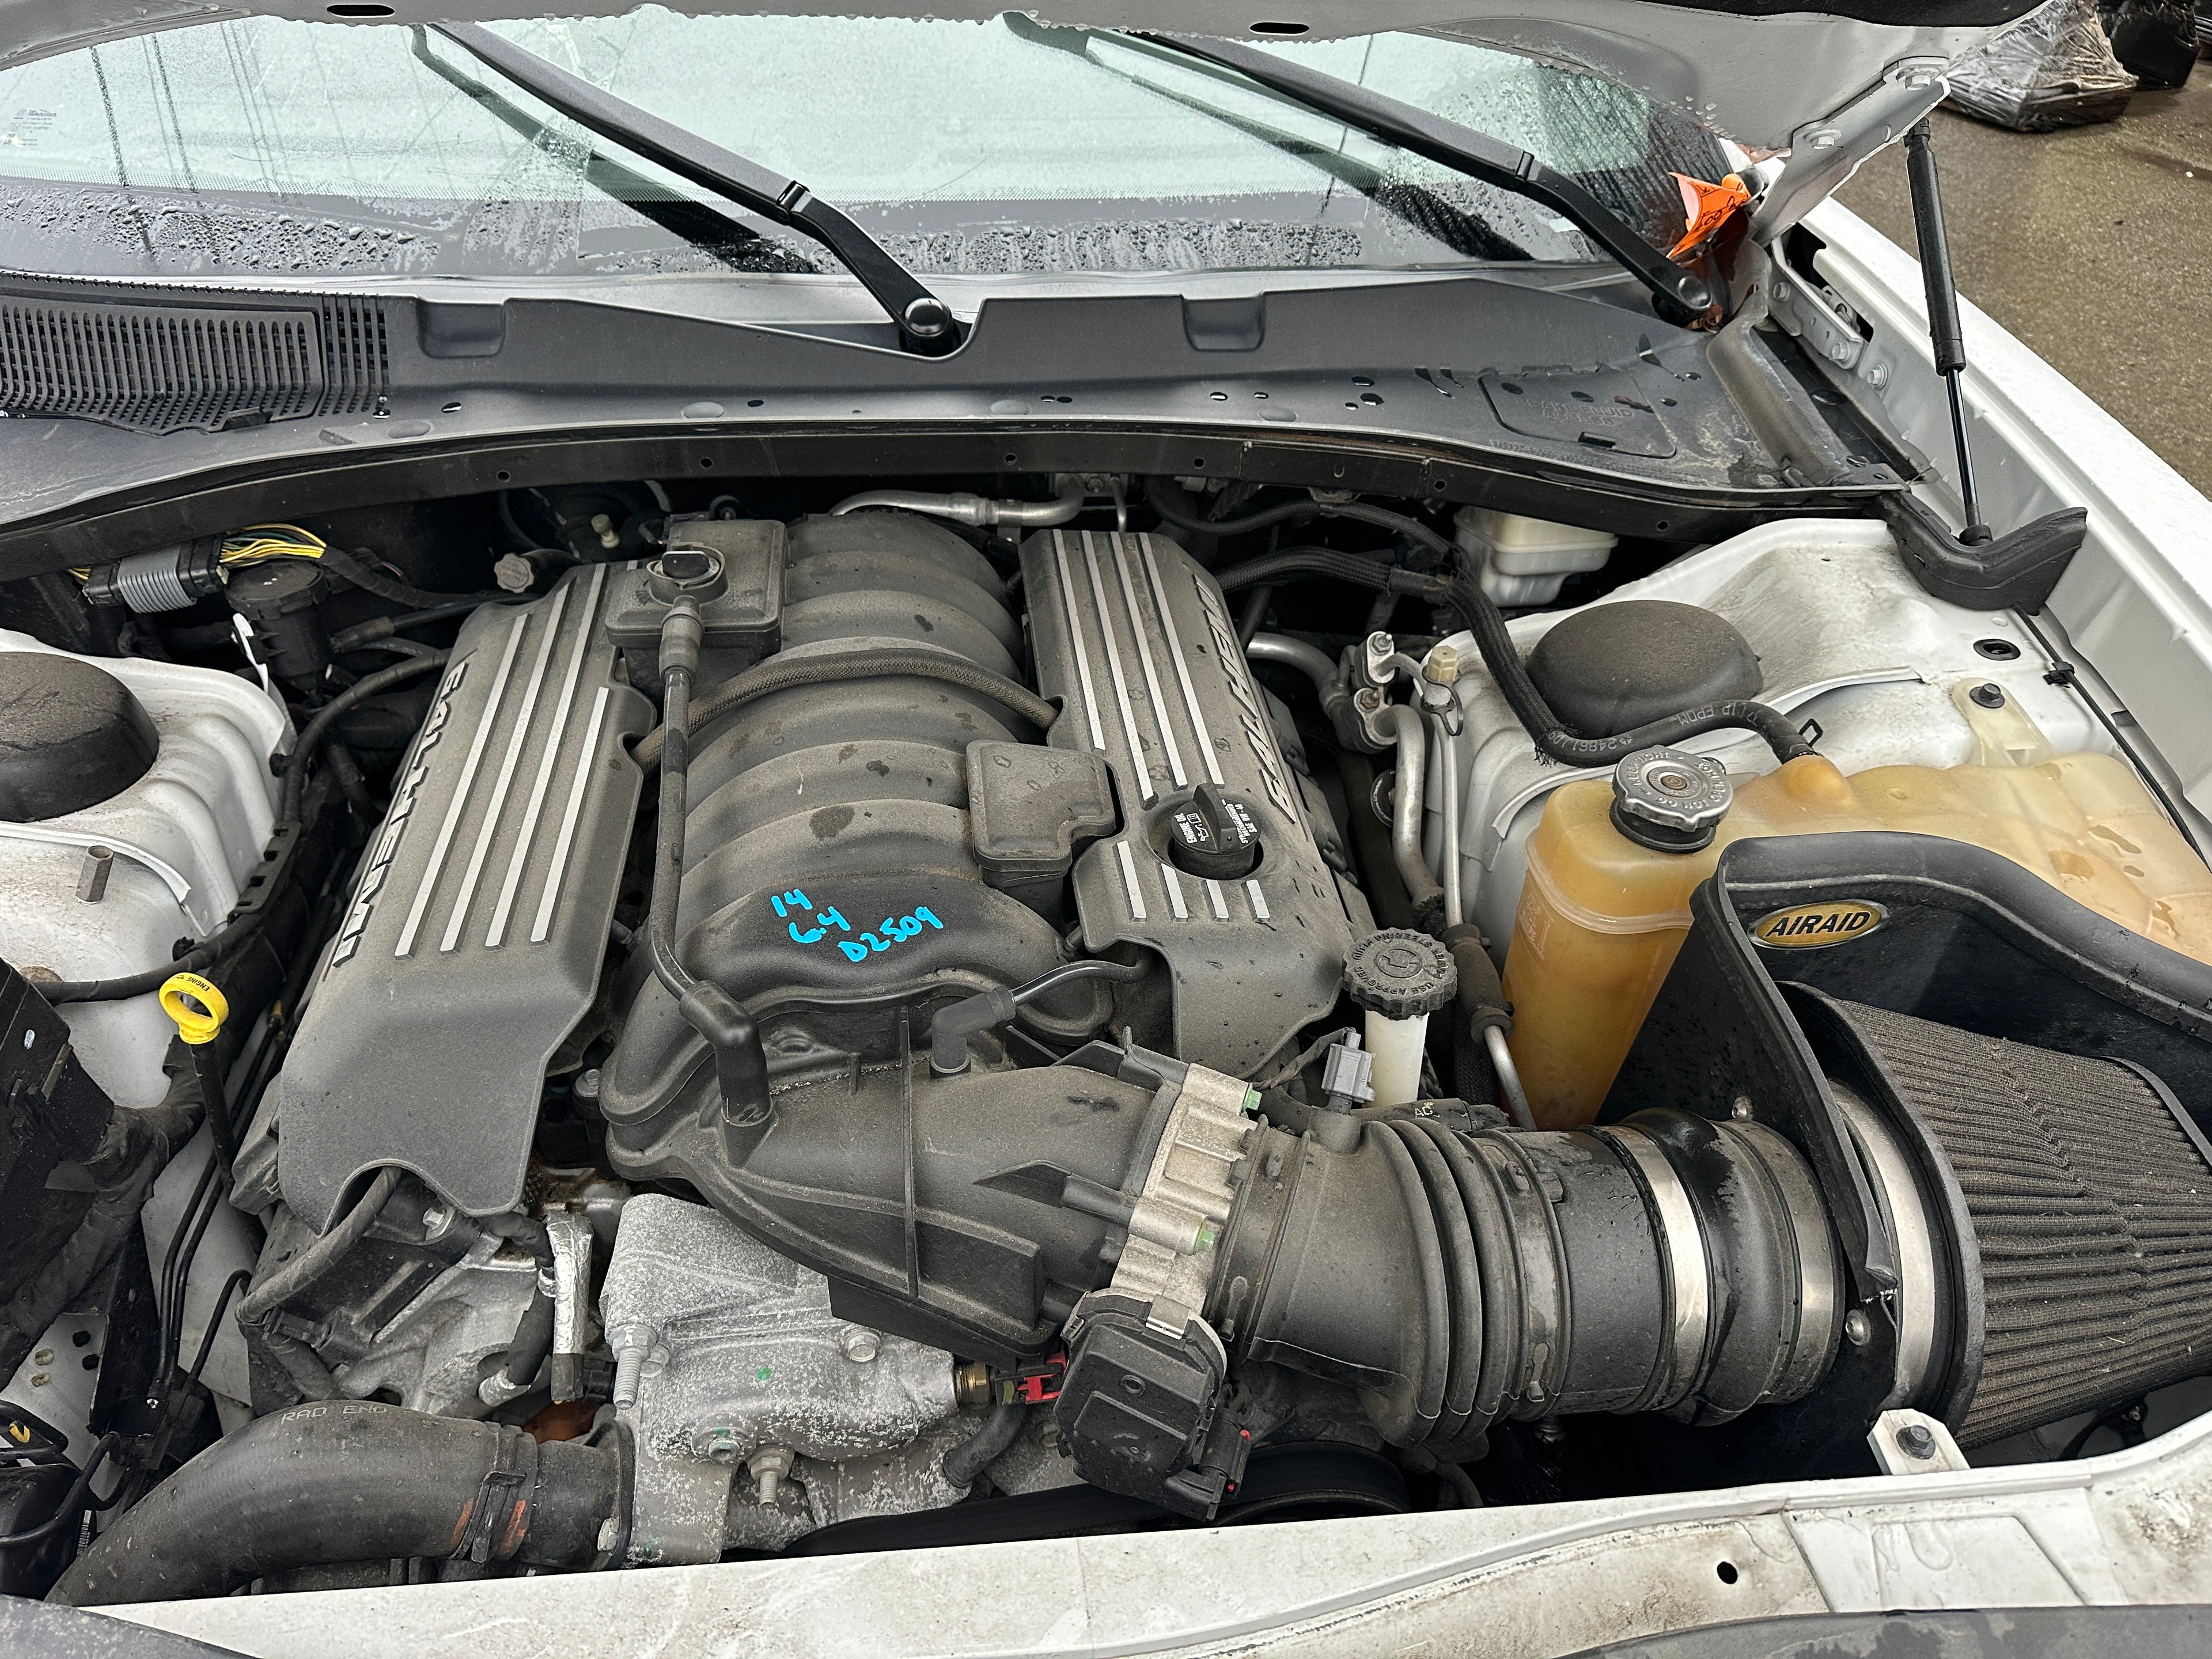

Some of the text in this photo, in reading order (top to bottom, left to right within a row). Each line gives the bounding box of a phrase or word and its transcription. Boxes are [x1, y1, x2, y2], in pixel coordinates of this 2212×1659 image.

[1515, 396, 1634, 418] BRAKE FLUID
[1543, 409, 1615, 426] ACCESS
[1193, 574, 1257, 719] HEMI
[1656, 797, 1677, 807] DO
[1681, 799, 1710, 810] NOT
[1174, 812, 1198, 844] ENGINE OIL
[1247, 822, 1257, 833] SAE
[771, 888, 813, 918] 14
[789, 906, 851, 944] 6.4
[837, 906, 944, 963] D2509
[1764, 911, 1871, 937] AIRAID
[1353, 932, 1449, 980] POWER STEERING FLUID
[186, 976, 210, 991] ENGINE
[1354, 966, 1435, 996] USE APPROVED
[281, 1404, 387, 1425] RAD END
